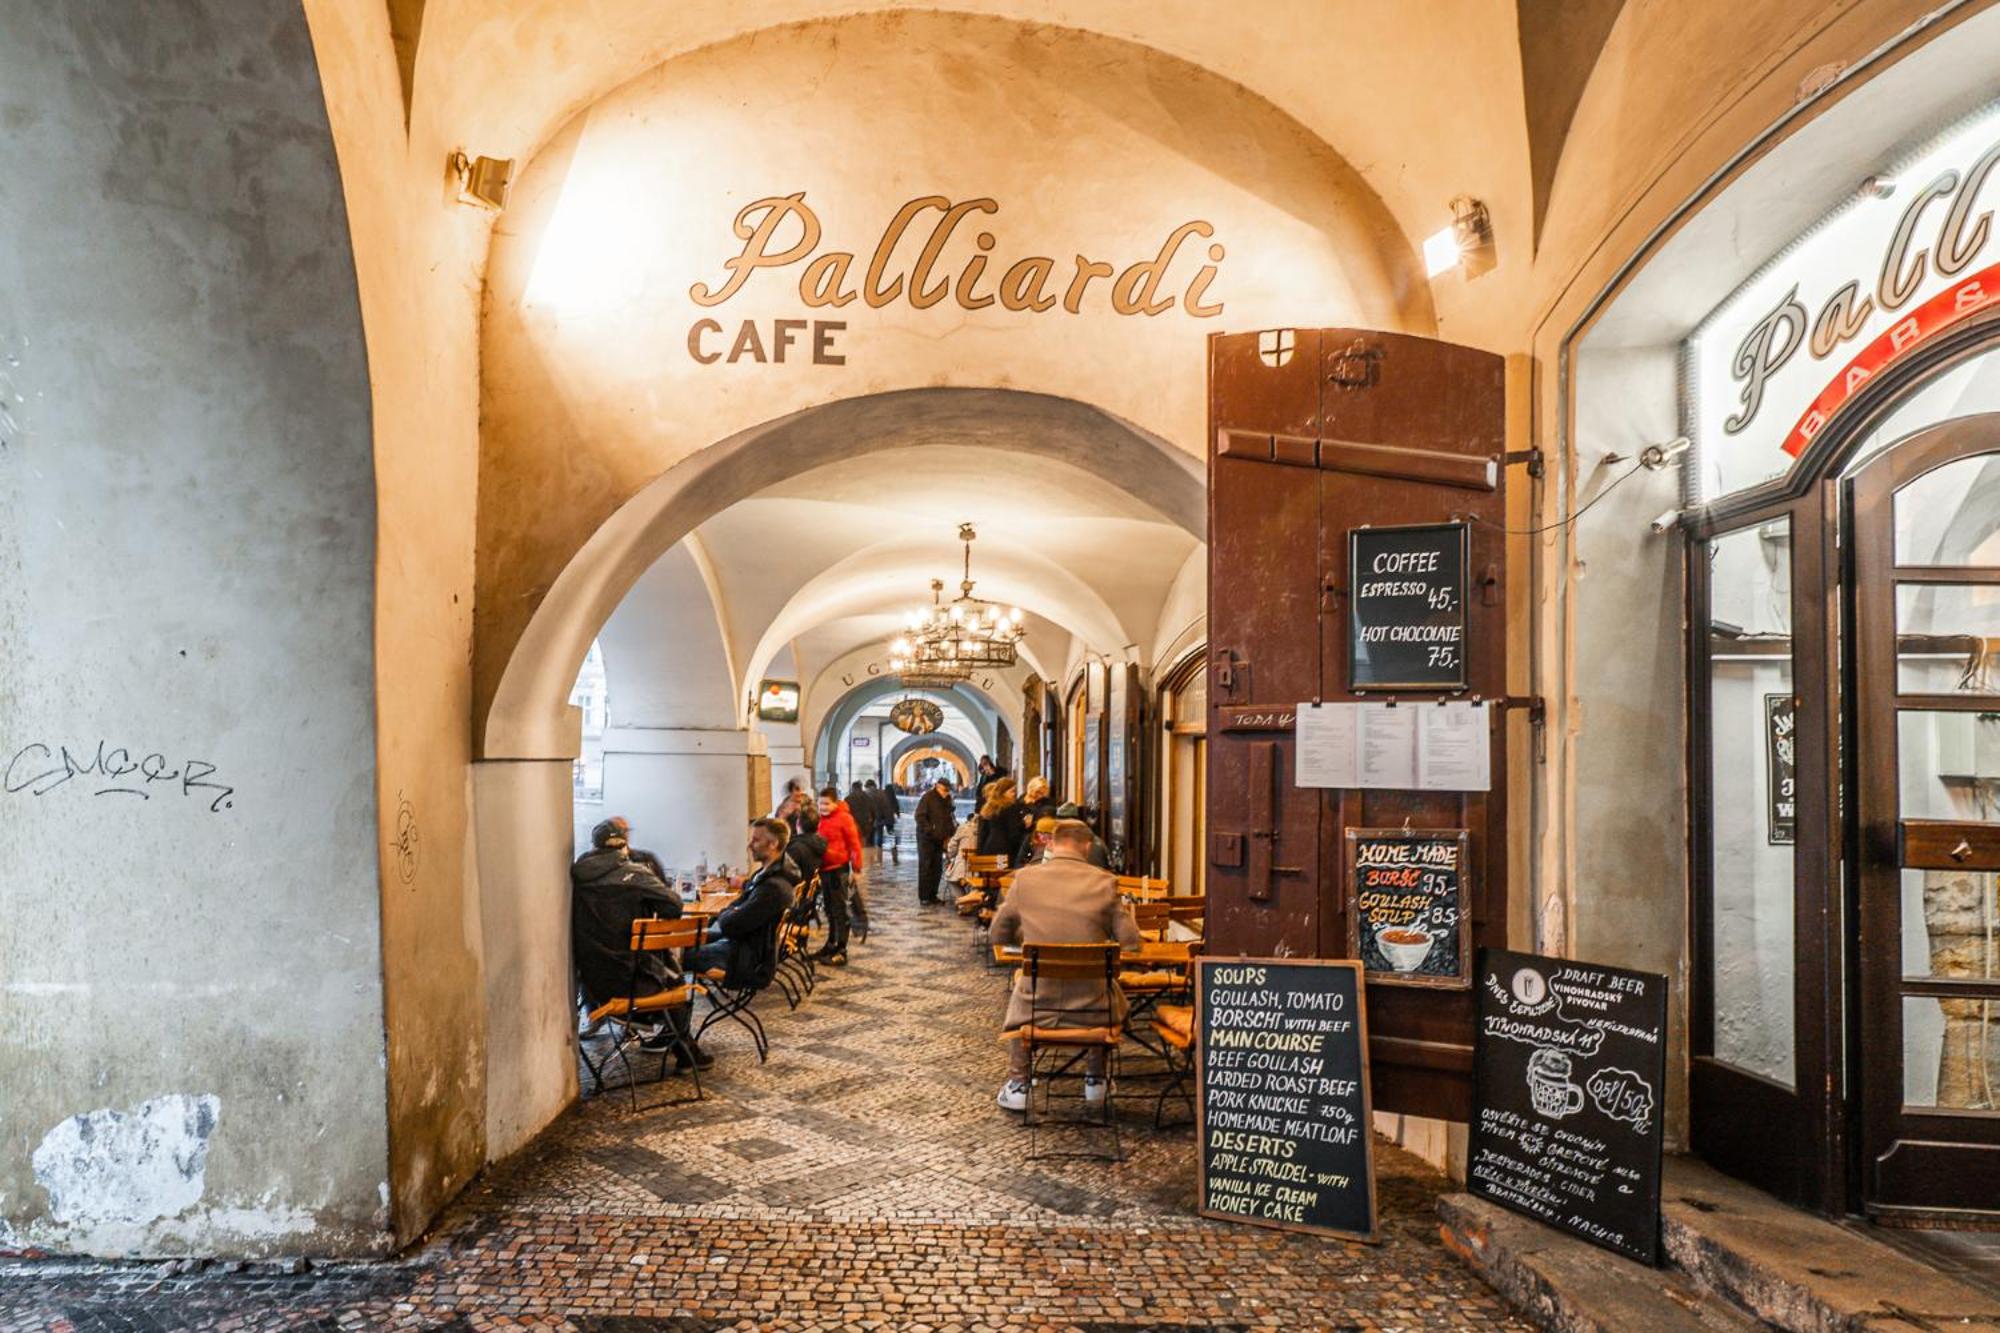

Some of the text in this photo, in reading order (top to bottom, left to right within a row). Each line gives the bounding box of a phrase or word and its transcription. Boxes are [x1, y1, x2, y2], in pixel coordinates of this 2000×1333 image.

[689, 192, 1226, 318] Palliardi
[687, 318, 848, 366] CAFE
[1373, 551, 1441, 574] COFFEE
[1360, 581, 1427, 598] ESPRESSO
[1359, 625, 1462, 643] HOT CHOCOLATE
[1357, 845, 1458, 864] HOME MADE
[1359, 892, 1433, 910] GOULASH
[1367, 909, 1416, 924] SOUP
[1213, 967, 1267, 986] SOUPS
[1485, 973, 1509, 1005] DNES
[1562, 968, 1646, 997] DRAFT BEER
[1286, 991, 1344, 1012] TOMATO
[1566, 995, 1608, 1012] PIVOVAR
[1210, 1007, 1351, 1033] BORSCHT WITH BEEF
[1209, 1029, 1325, 1053] MAIN COURSE
[1207, 1050, 1325, 1076] BEEF GOULASH
[1207, 1070, 1357, 1097] LARDED ROAST BEEF
[1207, 1089, 1247, 1109] PORK
[1247, 1093, 1311, 1115] KNUCKLE
[1207, 1109, 1359, 1145] HOMEMADE MEATLOAF
[1210, 1131, 1297, 1158] DESERTS
[1209, 1153, 1249, 1173] APPLE
[1248, 1158, 1308, 1184] STRUDEL
[1317, 1172, 1350, 1189] WITH
[1208, 1177, 1318, 1207] VANILLA ICE CREAM
[1208, 1192, 1305, 1223] HONEY CAKE
